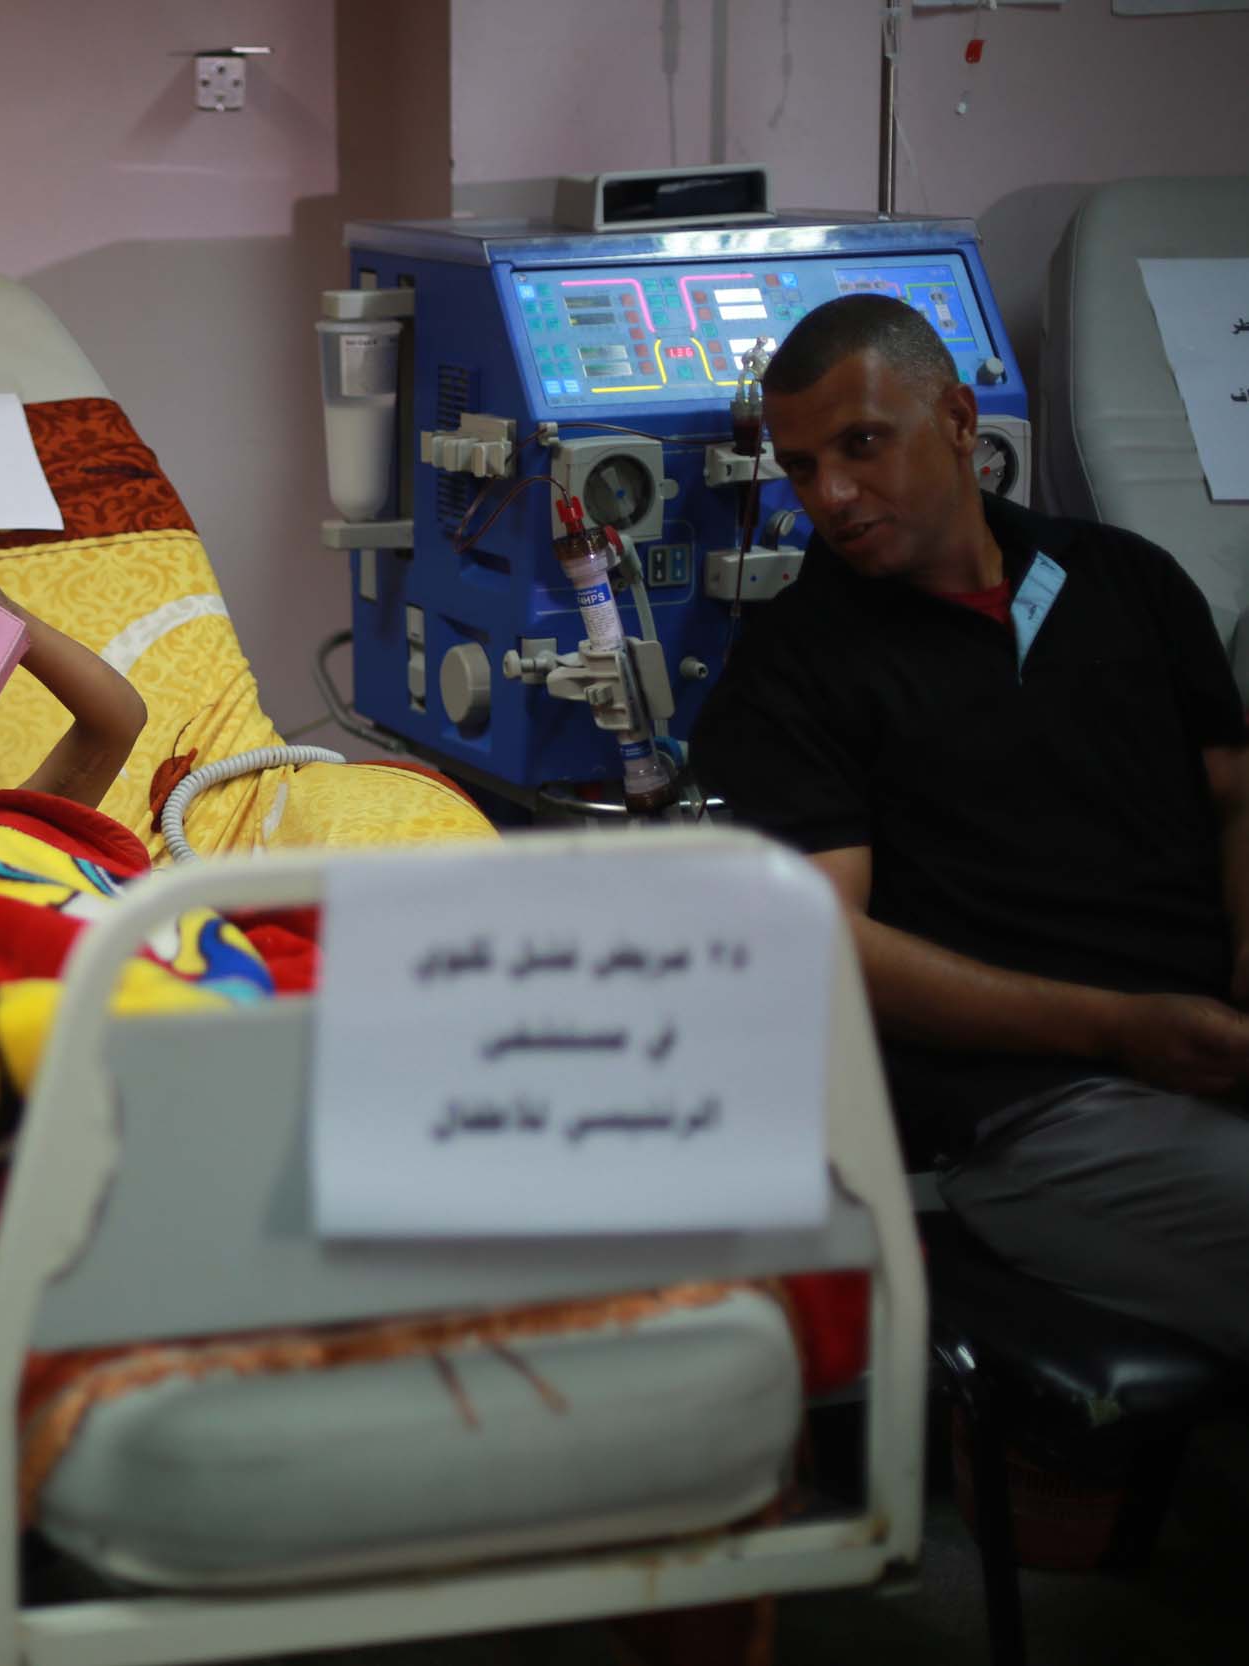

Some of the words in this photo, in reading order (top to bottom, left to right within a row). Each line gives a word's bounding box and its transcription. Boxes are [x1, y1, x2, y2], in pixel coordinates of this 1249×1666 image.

[507, 933, 579, 982] فشل
[589, 934, 691, 982] مريض
[645, 1012, 680, 1064] في
